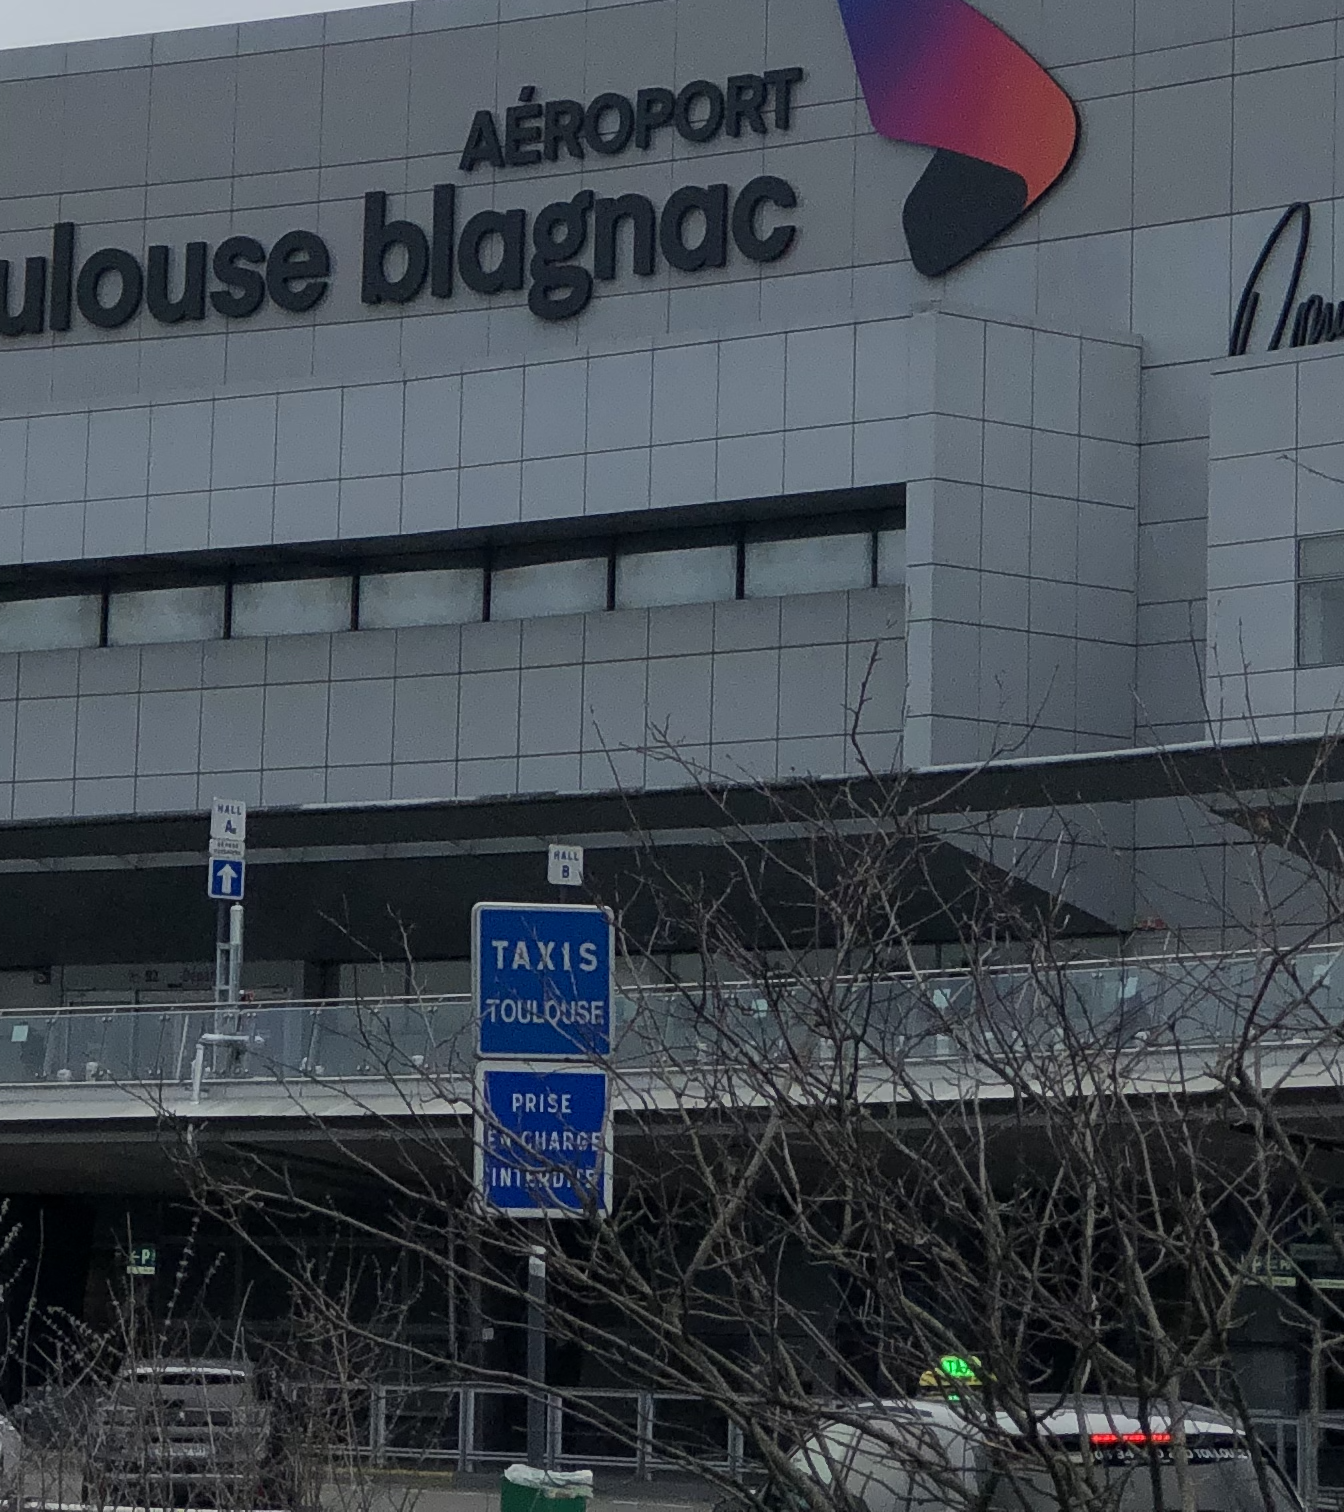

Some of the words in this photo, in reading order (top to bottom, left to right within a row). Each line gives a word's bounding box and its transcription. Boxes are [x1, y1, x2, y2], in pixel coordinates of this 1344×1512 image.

[458, 67, 804, 173] AÉROPORT
[361, 174, 803, 324] blagnac
[217, 803, 243, 816] HALL
[553, 850, 579, 862] HALL
[561, 865, 571, 879] B
[491, 940, 599, 972] TAXIS
[485, 998, 605, 1026] TOULOUSE
[511, 1093, 572, 1114] PRISE
[521, 1130, 602, 1152] CHARGE
